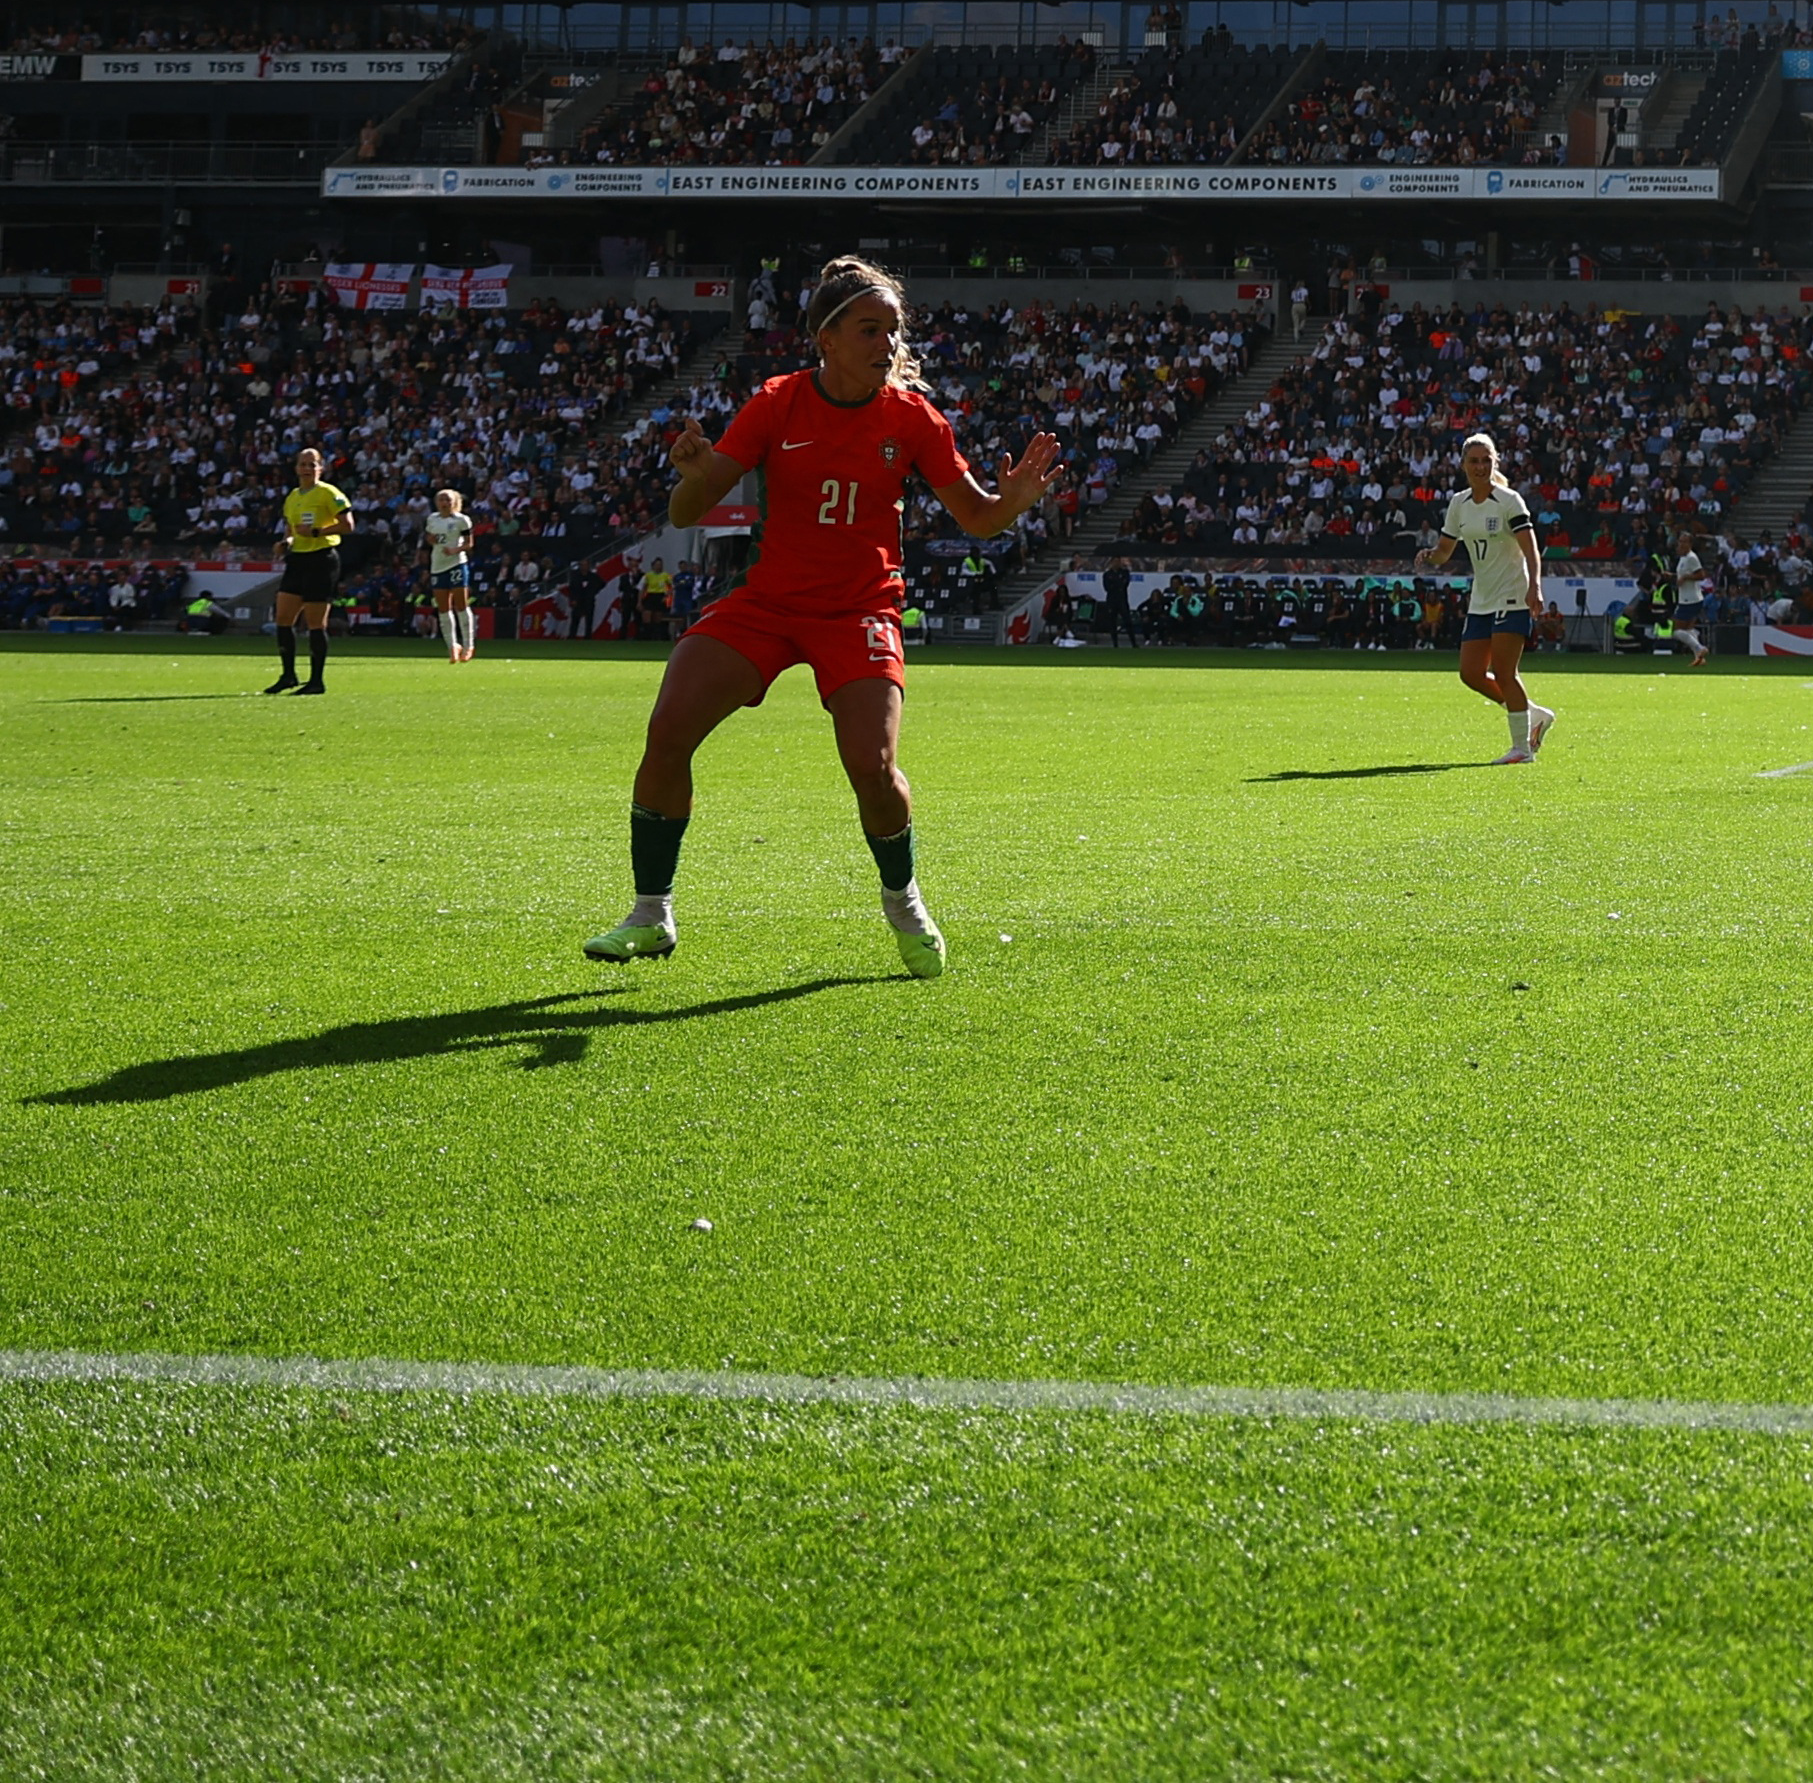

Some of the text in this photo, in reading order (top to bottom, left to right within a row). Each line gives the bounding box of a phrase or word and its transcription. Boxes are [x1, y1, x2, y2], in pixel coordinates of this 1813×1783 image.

[0, 56, 58, 75] EMW
[103, 62, 139, 74] TSYS
[155, 62, 191, 74] TSYS
[208, 62, 245, 74] TSYS
[272, 61, 301, 73] SYS
[311, 62, 347, 73] TSYS
[367, 62, 403, 73] TSYS
[463, 178, 535, 188] FABRICATION
[575, 173, 643, 182] ENGINEERING
[671, 176, 980, 191] EAST ENGINEERING COMPONENTS
[1389, 174, 1460, 183] ENGINEERING
[1628, 175, 1688, 184] HYDRAULICS
[575, 183, 642, 192] COMPONENTS
[1023, 177, 1337, 191] EAST ENGINEERING COMPONENTS
[1389, 184, 1459, 193] COMPONENTS
[1509, 179, 1585, 189] FABRICATION
[1628, 185, 1714, 194] AND PNEUMATICS
[185, 283, 199, 294] 21
[711, 285, 726, 297] 22
[1255, 287, 1270, 299] 23
[818, 479, 858, 525] 21
[1473, 539, 1487, 560] 17
[450, 569, 463, 583] 22
[862, 615, 897, 653] 21
